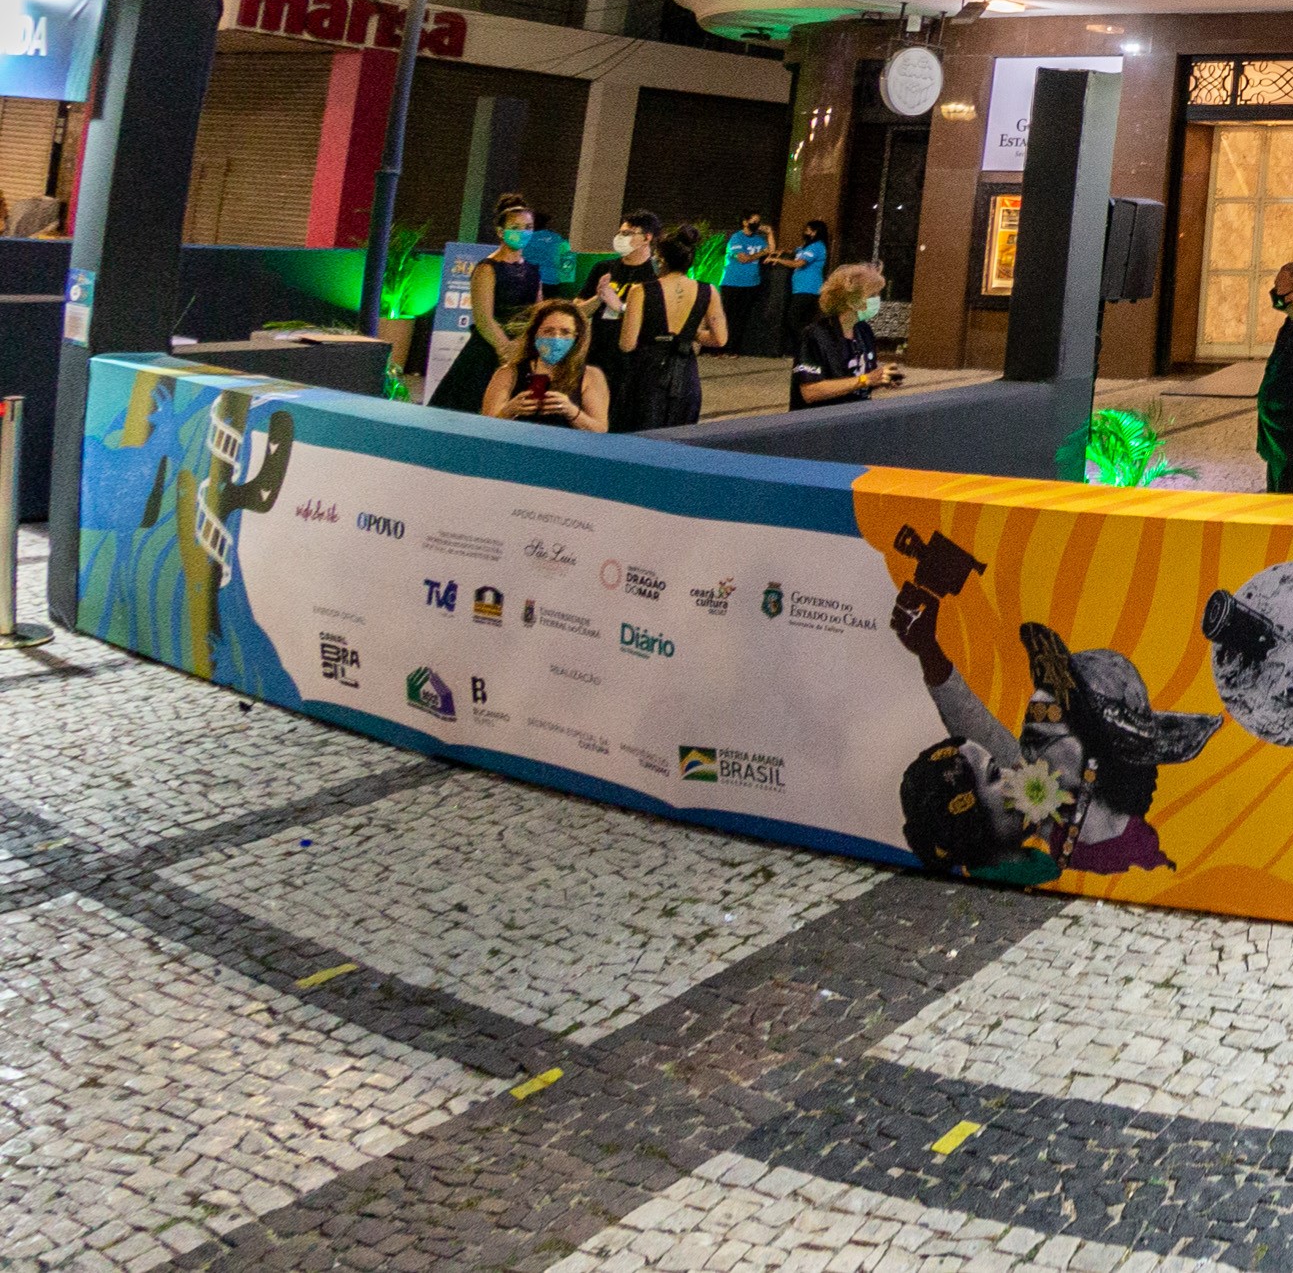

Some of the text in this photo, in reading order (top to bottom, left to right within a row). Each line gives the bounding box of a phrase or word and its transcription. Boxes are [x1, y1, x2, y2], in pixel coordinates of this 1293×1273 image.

[999, 133, 1027, 148] ESTA
[524, 538, 549, 558] São
[550, 542, 577, 567] Luiz
[689, 587, 715, 599] ceará
[696, 597, 729, 610] cultura
[790, 590, 854, 613] GOVERNO DO
[789, 603, 877, 631] ESTADO DO CEARÁ
[620, 622, 675, 658] Diário
[719, 747, 785, 767] PÁTRIA AMADA
[720, 759, 786, 787] BRASIL
